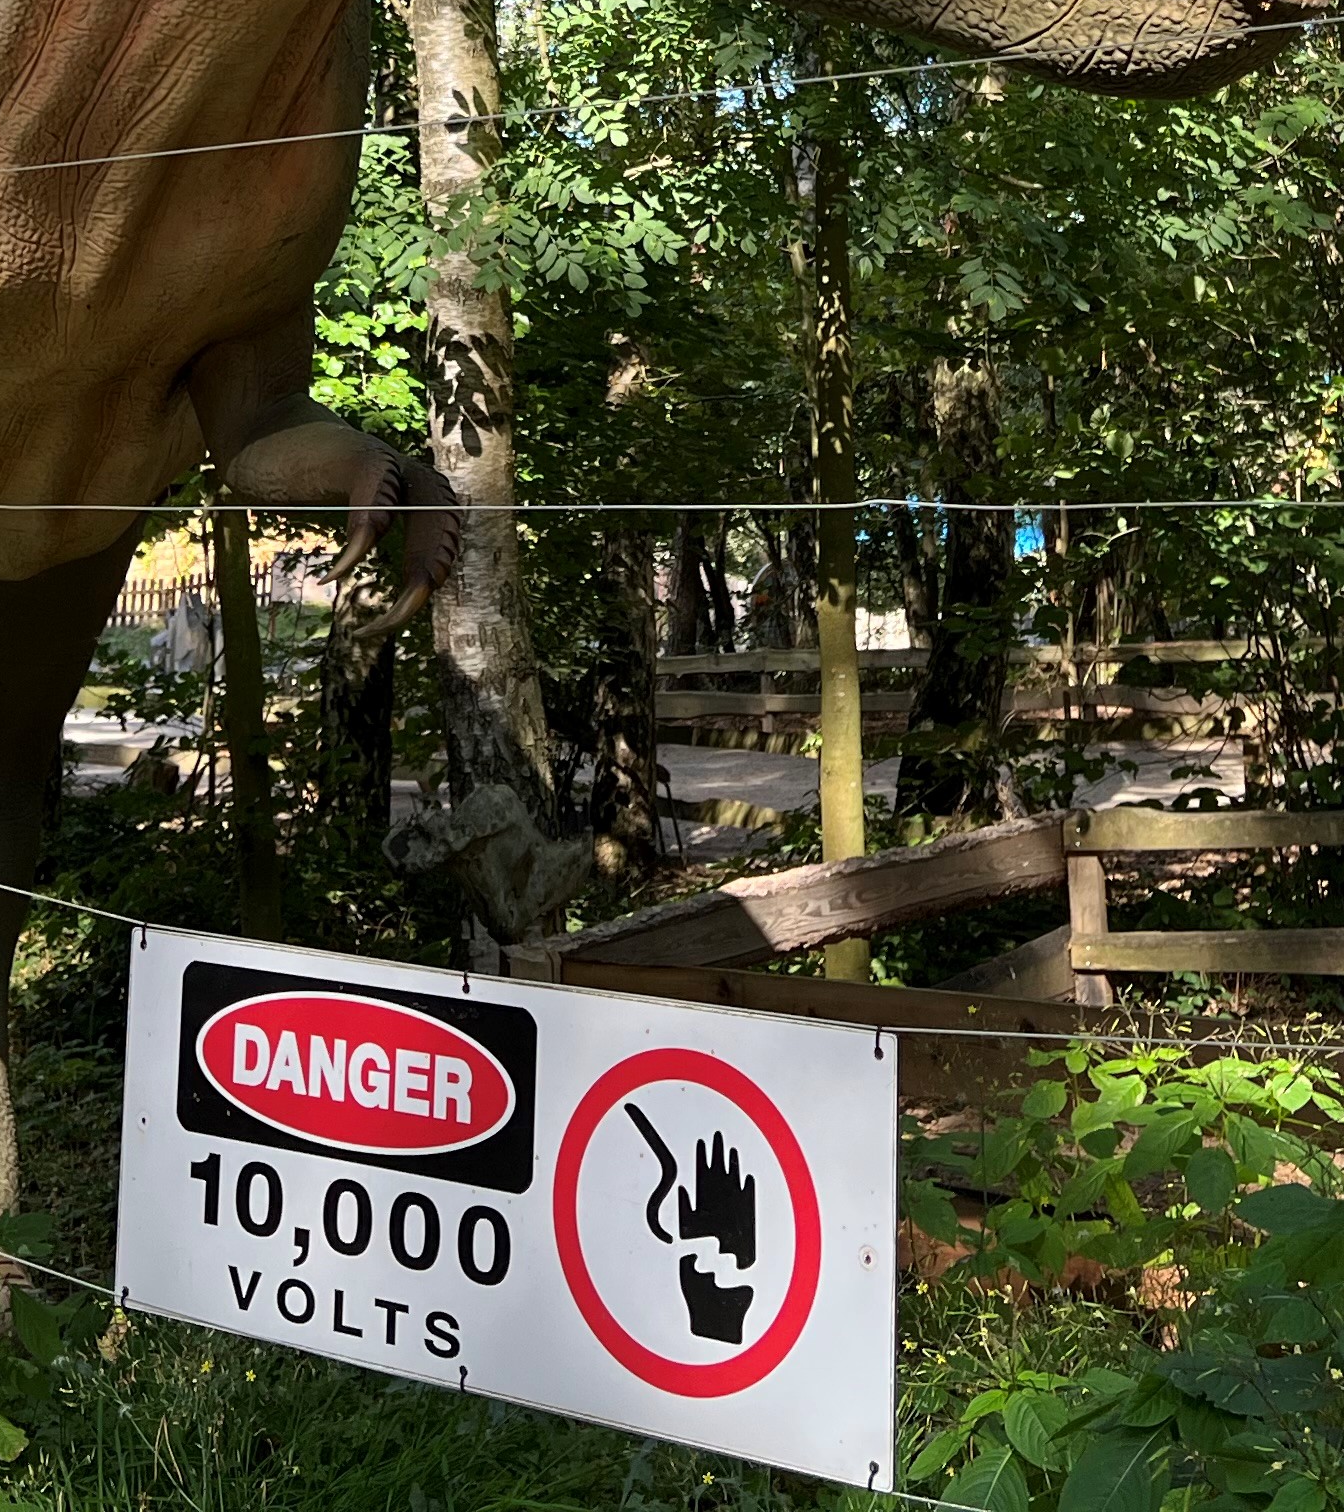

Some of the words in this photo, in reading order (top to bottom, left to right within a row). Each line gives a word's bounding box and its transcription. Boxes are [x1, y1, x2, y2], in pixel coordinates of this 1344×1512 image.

[231, 1022, 473, 1125] DANGER
[189, 1152, 512, 1286] 10,000
[227, 1265, 461, 1359] VOLTS
